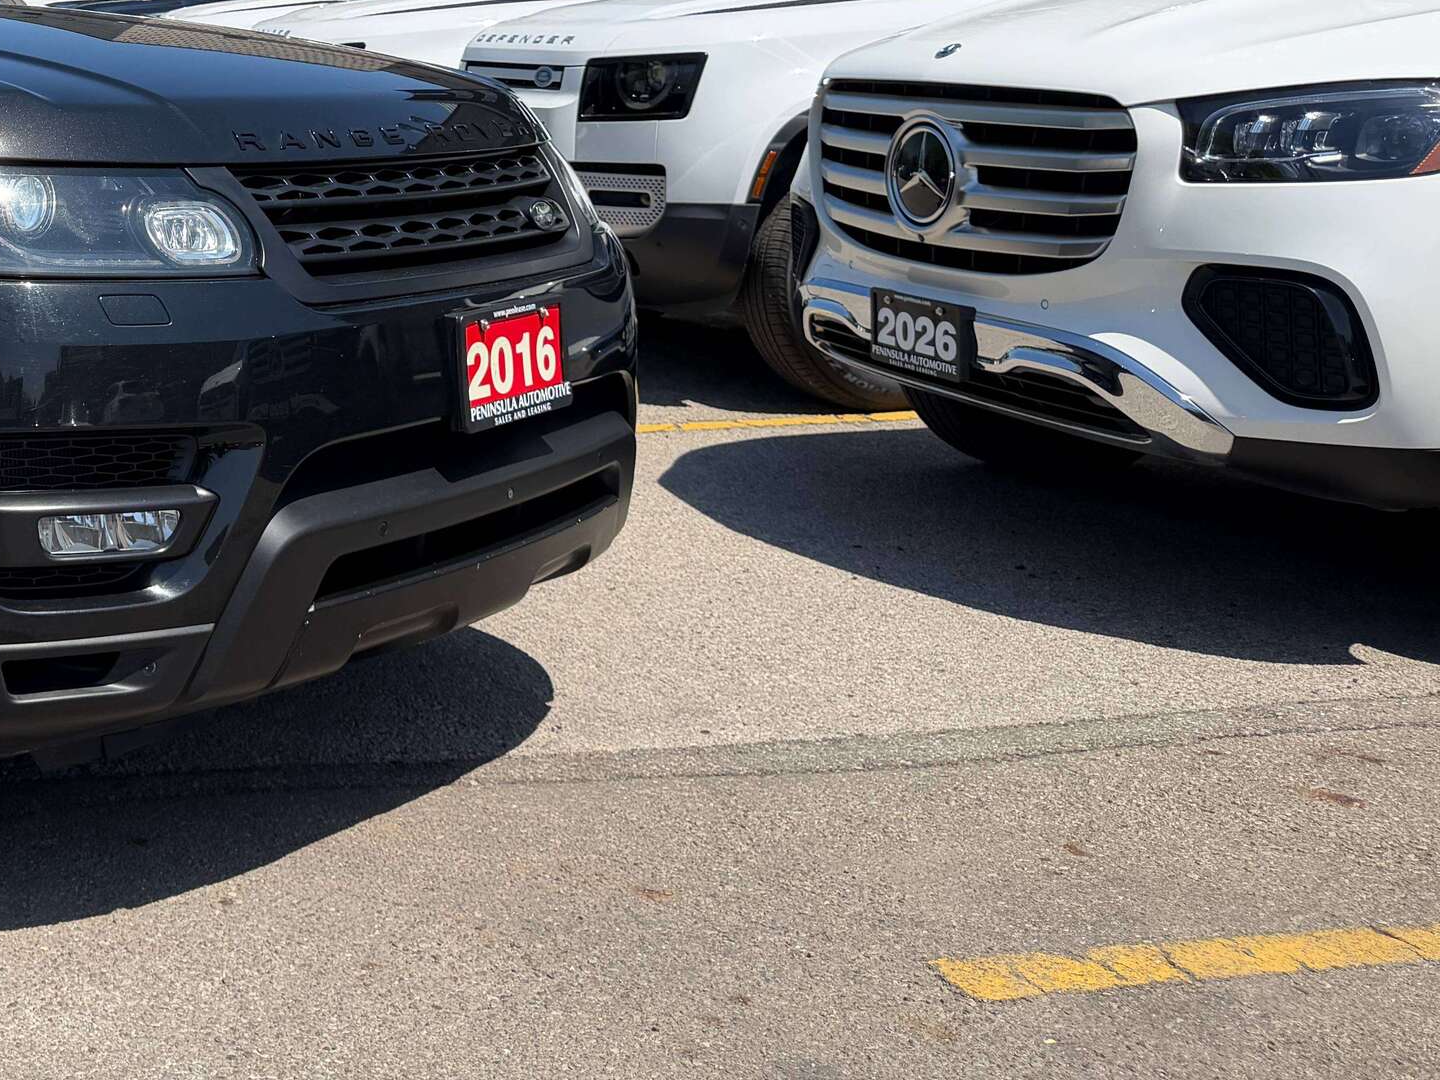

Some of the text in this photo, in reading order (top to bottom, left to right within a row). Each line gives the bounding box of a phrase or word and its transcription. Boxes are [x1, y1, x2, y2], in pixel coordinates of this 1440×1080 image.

[476, 33, 576, 45] DEFENDER
[231, 123, 406, 151] RANGE
[877, 307, 957, 362] 2026
[466, 325, 557, 401] 2016
[871, 344, 958, 376] PENINSULA AUTOMOTIVE
[470, 381, 572, 422] PENINSULA AUTOMOTIVE
[494, 402, 552, 426] SALES AND LEASING
